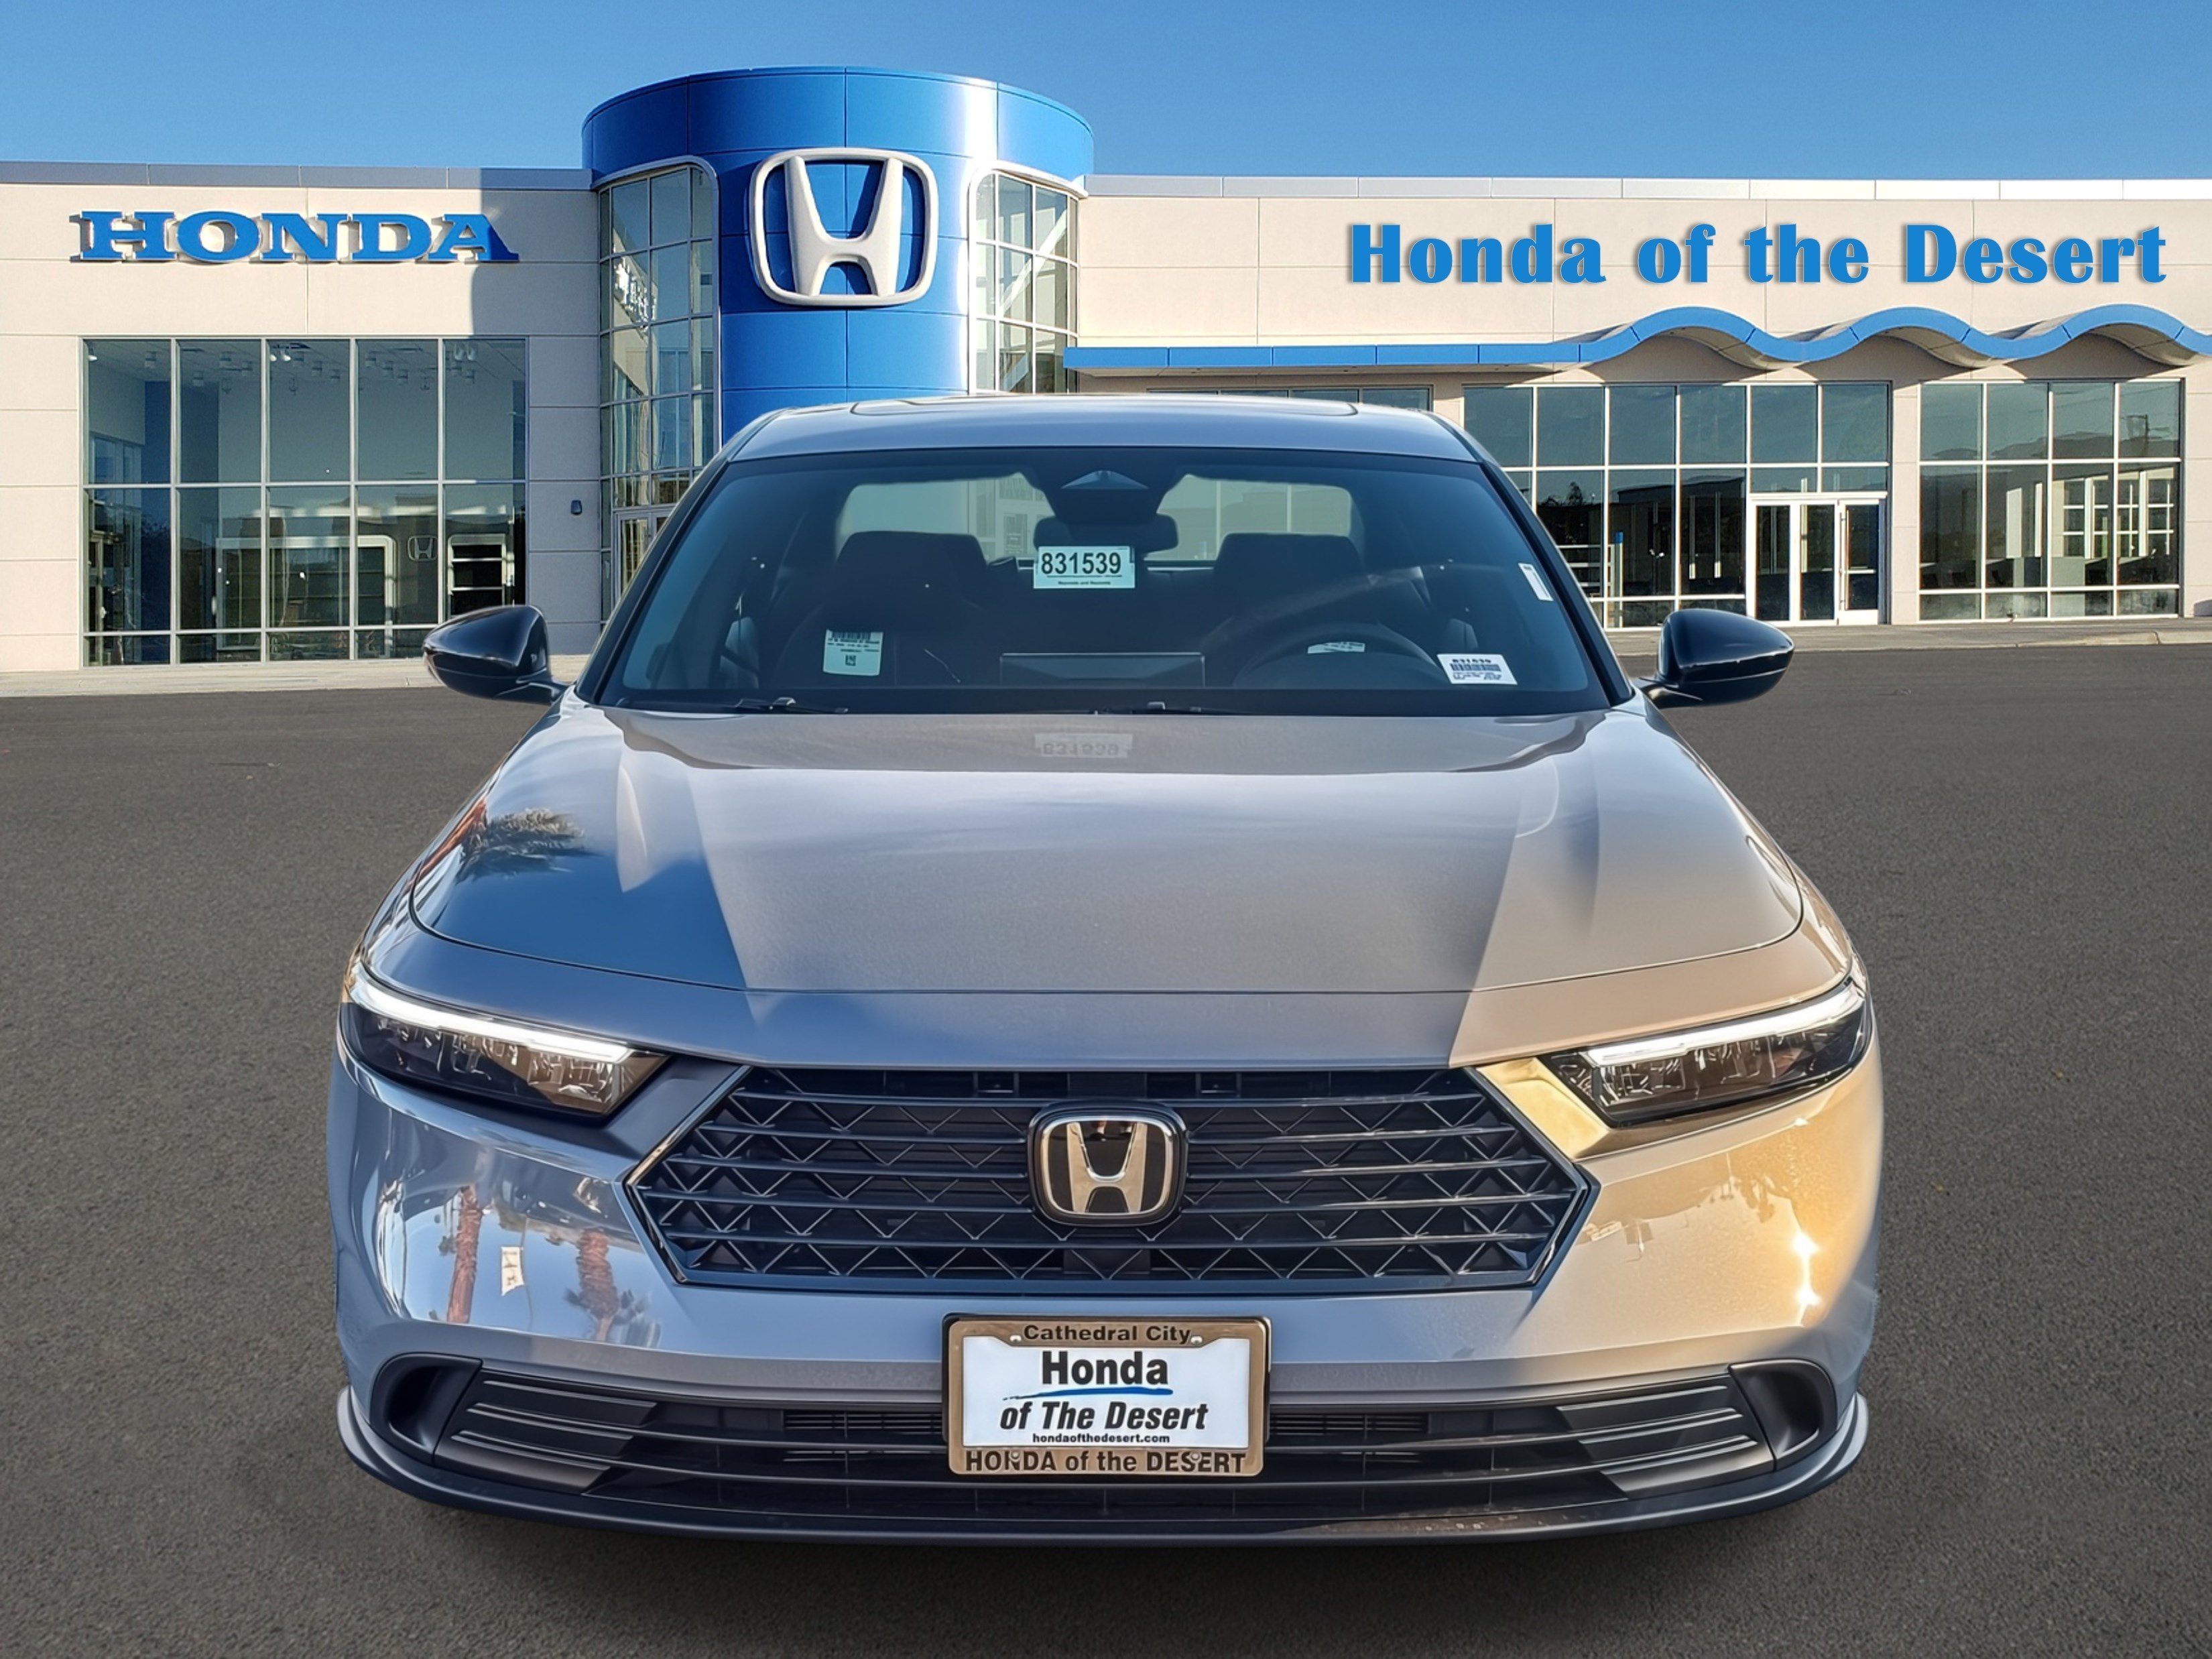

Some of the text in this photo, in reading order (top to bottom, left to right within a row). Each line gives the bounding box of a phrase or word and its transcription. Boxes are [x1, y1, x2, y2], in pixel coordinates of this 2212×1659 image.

[75, 210, 519, 263] HONDA
[1350, 223, 2168, 284] Honda of the Desert
[1041, 552, 1121, 574] 831539
[1024, 1325, 1191, 1344] Cathedral City
[1042, 1351, 1168, 1385] Honda
[1000, 1402, 1209, 1430] of The Desert
[1032, 1433, 1170, 1443] hondaofthedesert.com
[966, 1451, 1246, 1473] HONDA of the DESERT
